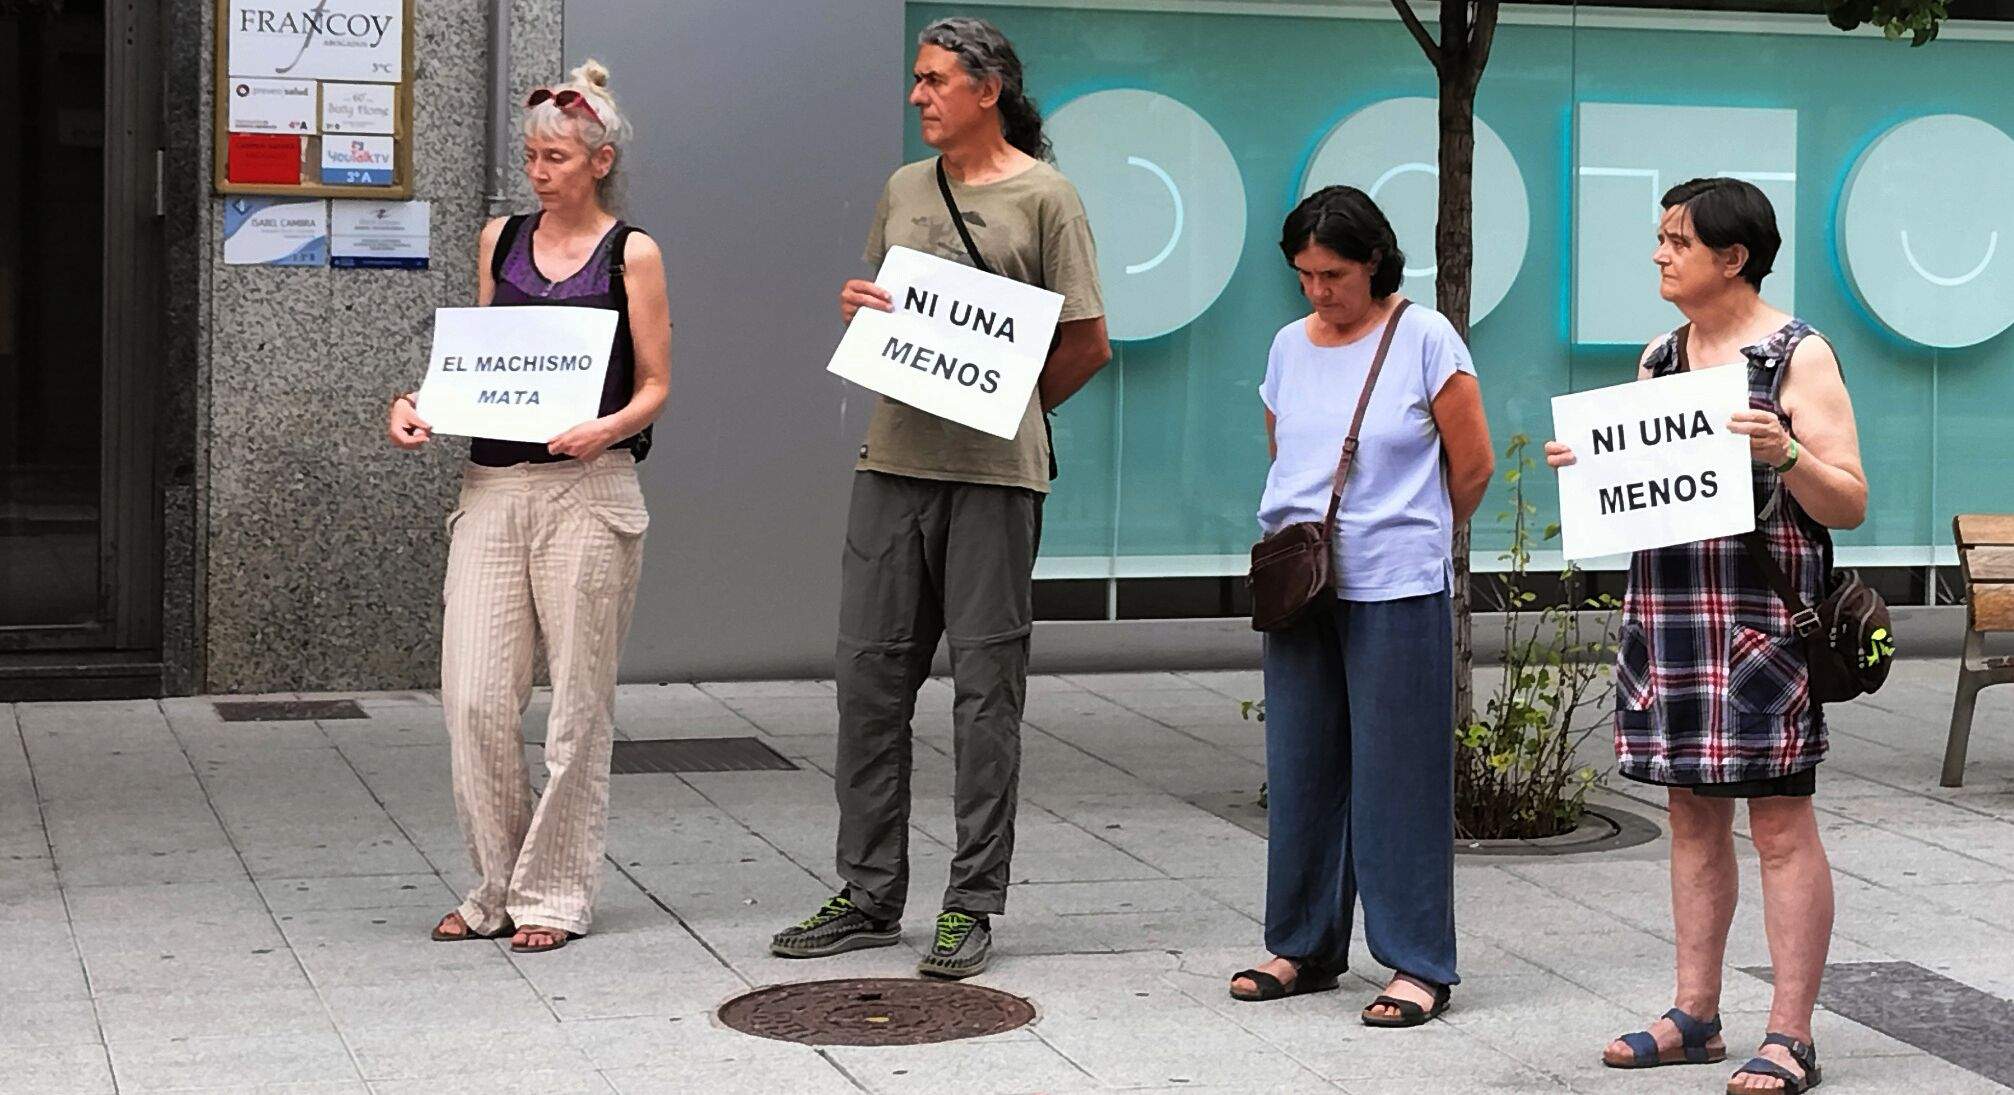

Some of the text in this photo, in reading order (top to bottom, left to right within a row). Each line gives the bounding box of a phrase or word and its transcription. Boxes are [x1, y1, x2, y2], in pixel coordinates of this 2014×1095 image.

[240, 9, 393, 48] FRANCOY
[904, 286, 1015, 343] NI UNA
[442, 355, 593, 371] EL MACHISMO
[881, 337, 1001, 394] MENOS
[477, 391, 540, 405] MATA
[1592, 410, 1715, 455] NI UNA
[1599, 470, 1719, 515] MENOS
